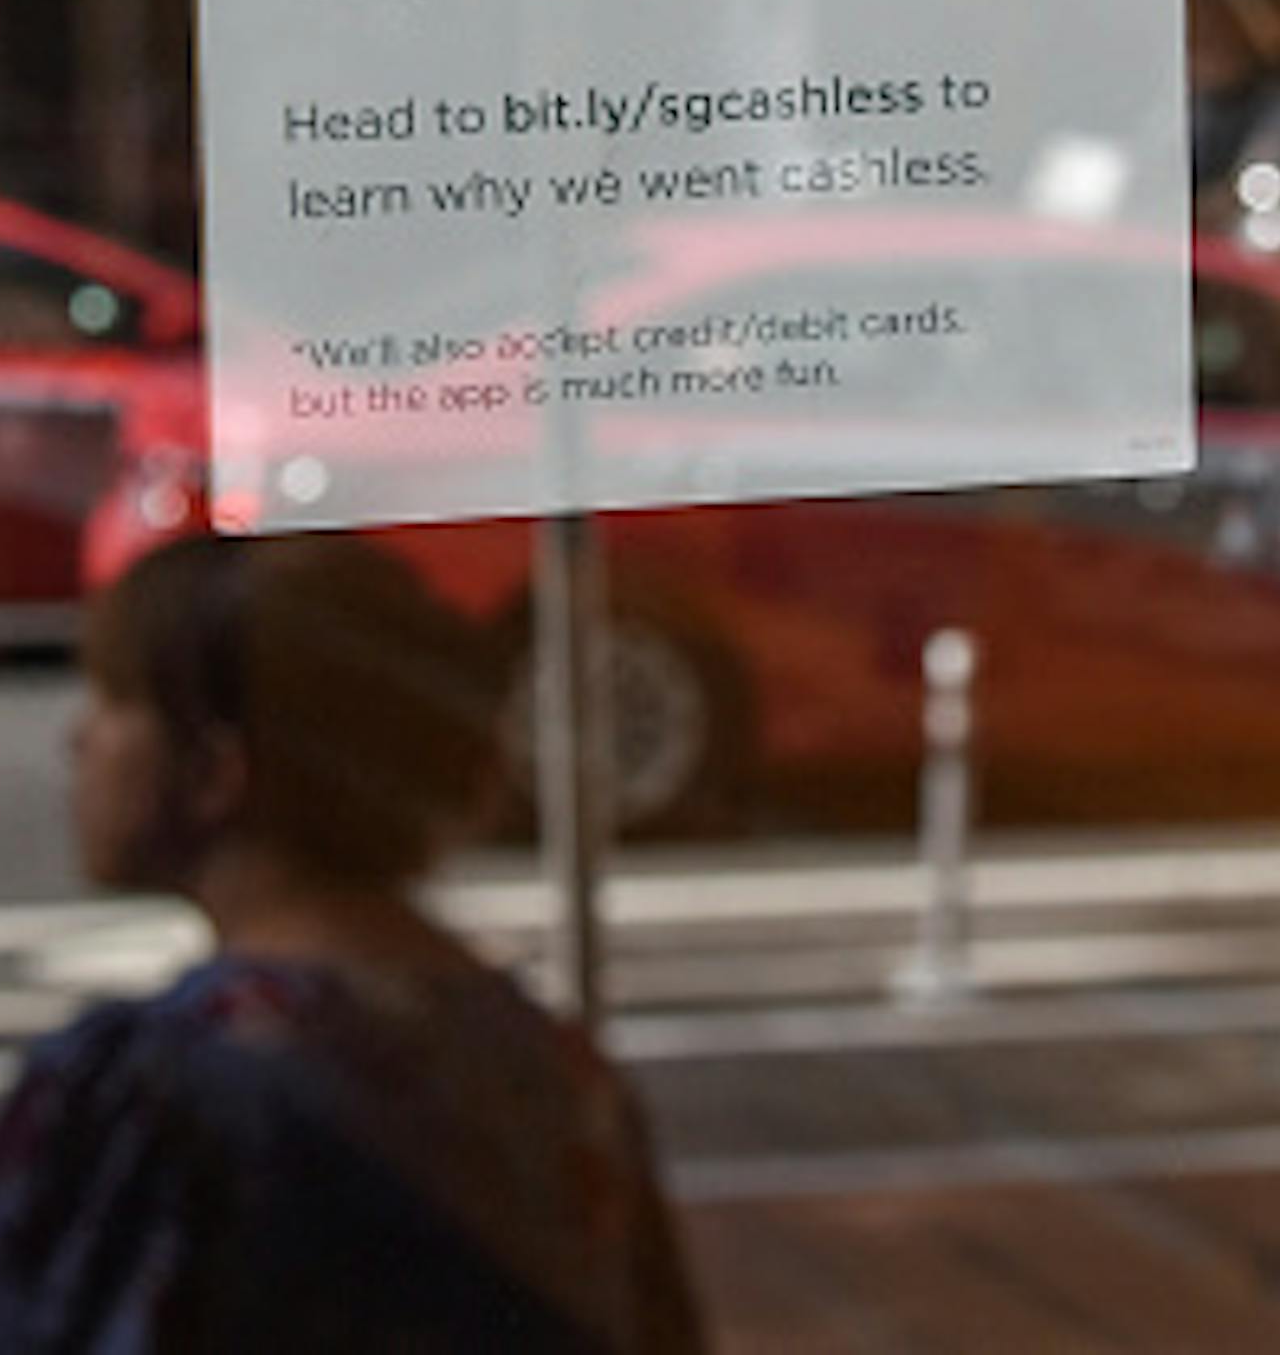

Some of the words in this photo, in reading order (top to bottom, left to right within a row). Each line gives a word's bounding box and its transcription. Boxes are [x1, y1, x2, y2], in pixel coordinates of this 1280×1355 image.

[284, 98, 415, 144] Head
[435, 98, 486, 137] to
[502, 77, 922, 134] bit.ly/sgcashless
[939, 73, 991, 112] to
[289, 177, 410, 220] learn
[428, 169, 532, 218] why
[549, 173, 622, 205] we
[640, 160, 761, 201] went
[780, 147, 990, 194] cashless.
[411, 330, 487, 366] also
[497, 322, 620, 366] accept
[632, 312, 849, 354] credit/debit
[290, 384, 358, 418] but
[368, 380, 426, 413] the
[438, 379, 511, 415] app
[523, 369, 550, 404] is
[561, 366, 661, 402] much
[672, 363, 764, 395] more
